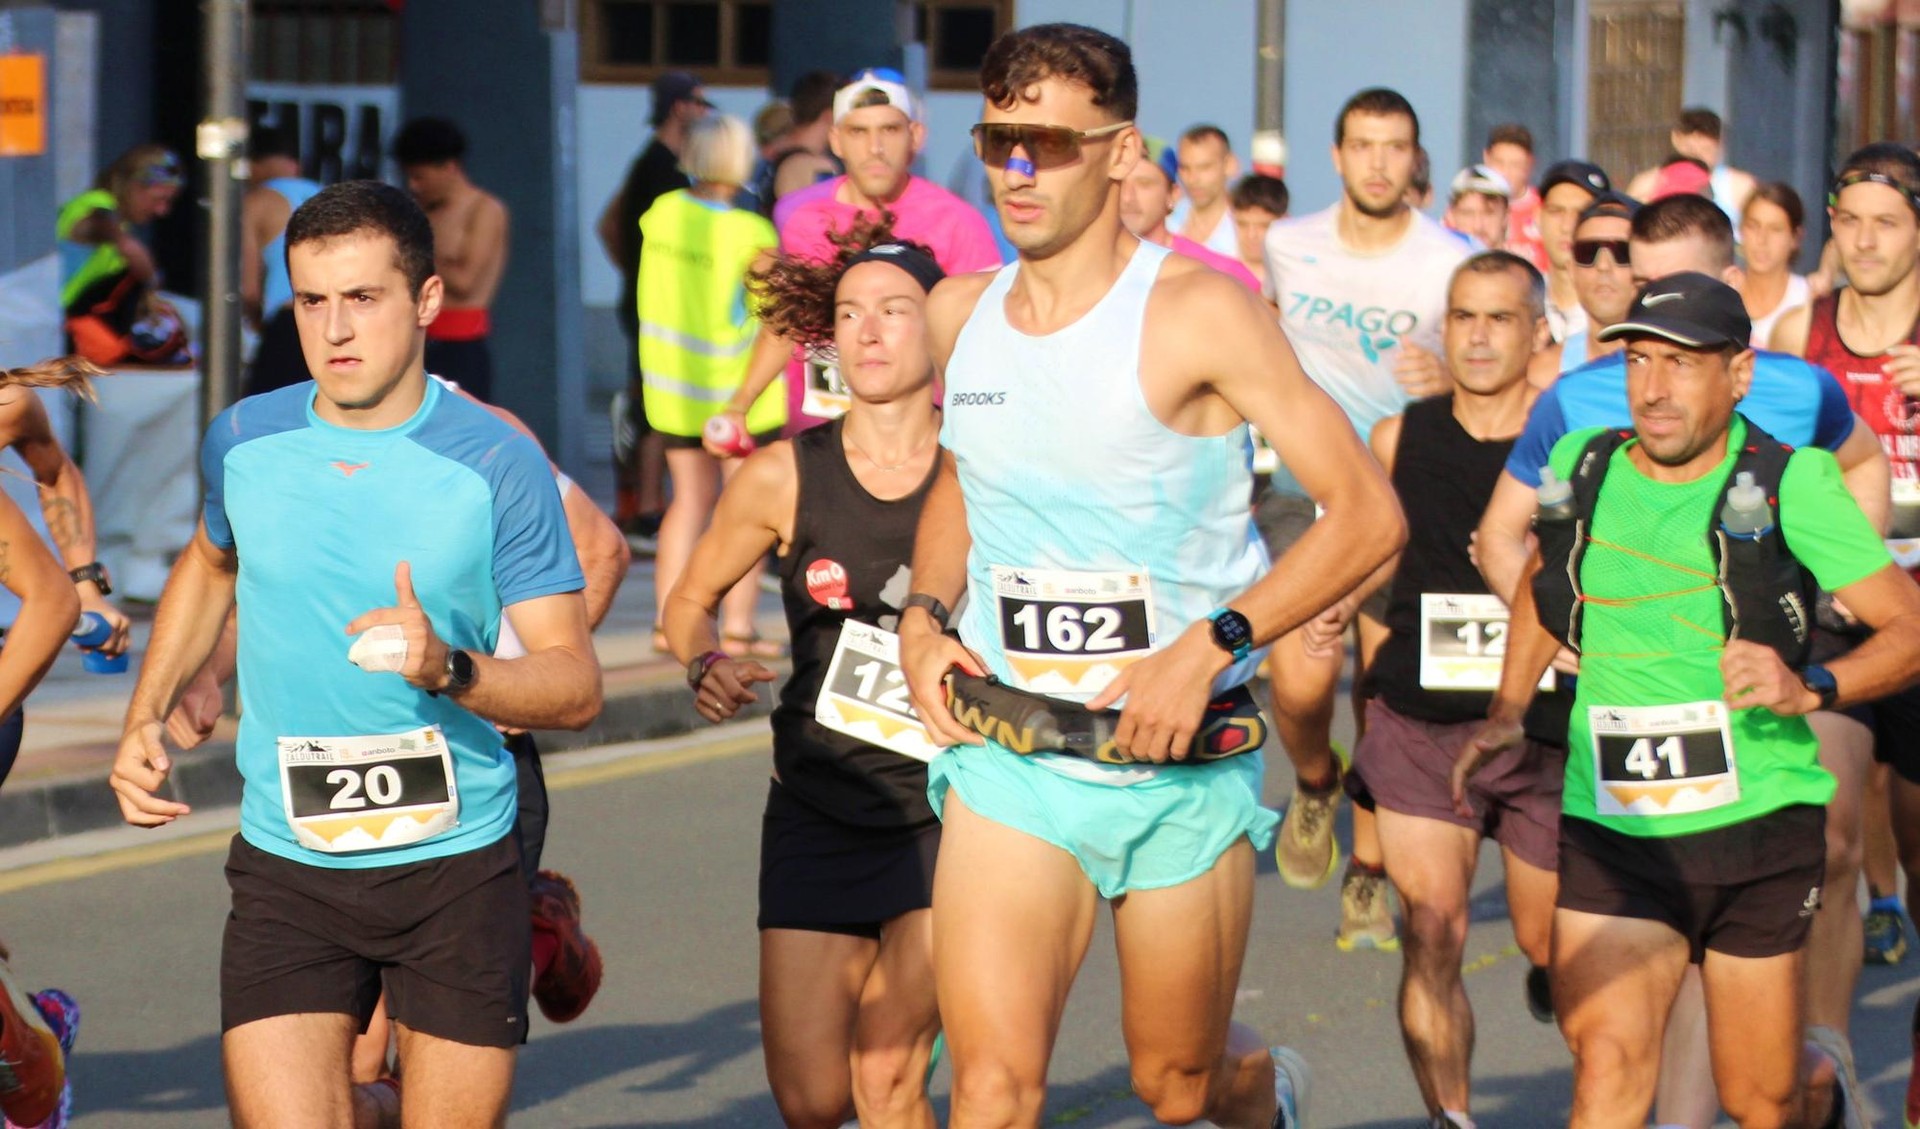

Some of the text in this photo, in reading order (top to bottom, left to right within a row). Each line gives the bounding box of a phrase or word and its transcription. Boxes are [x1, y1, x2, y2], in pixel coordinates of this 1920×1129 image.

[1287, 292, 1418, 337] 7PAGO
[951, 392, 1007, 406] BROOKS
[1013, 604, 1126, 651] 162
[853, 660, 921, 717] 12
[1624, 735, 1689, 780] 41
[325, 764, 402, 810] 20
